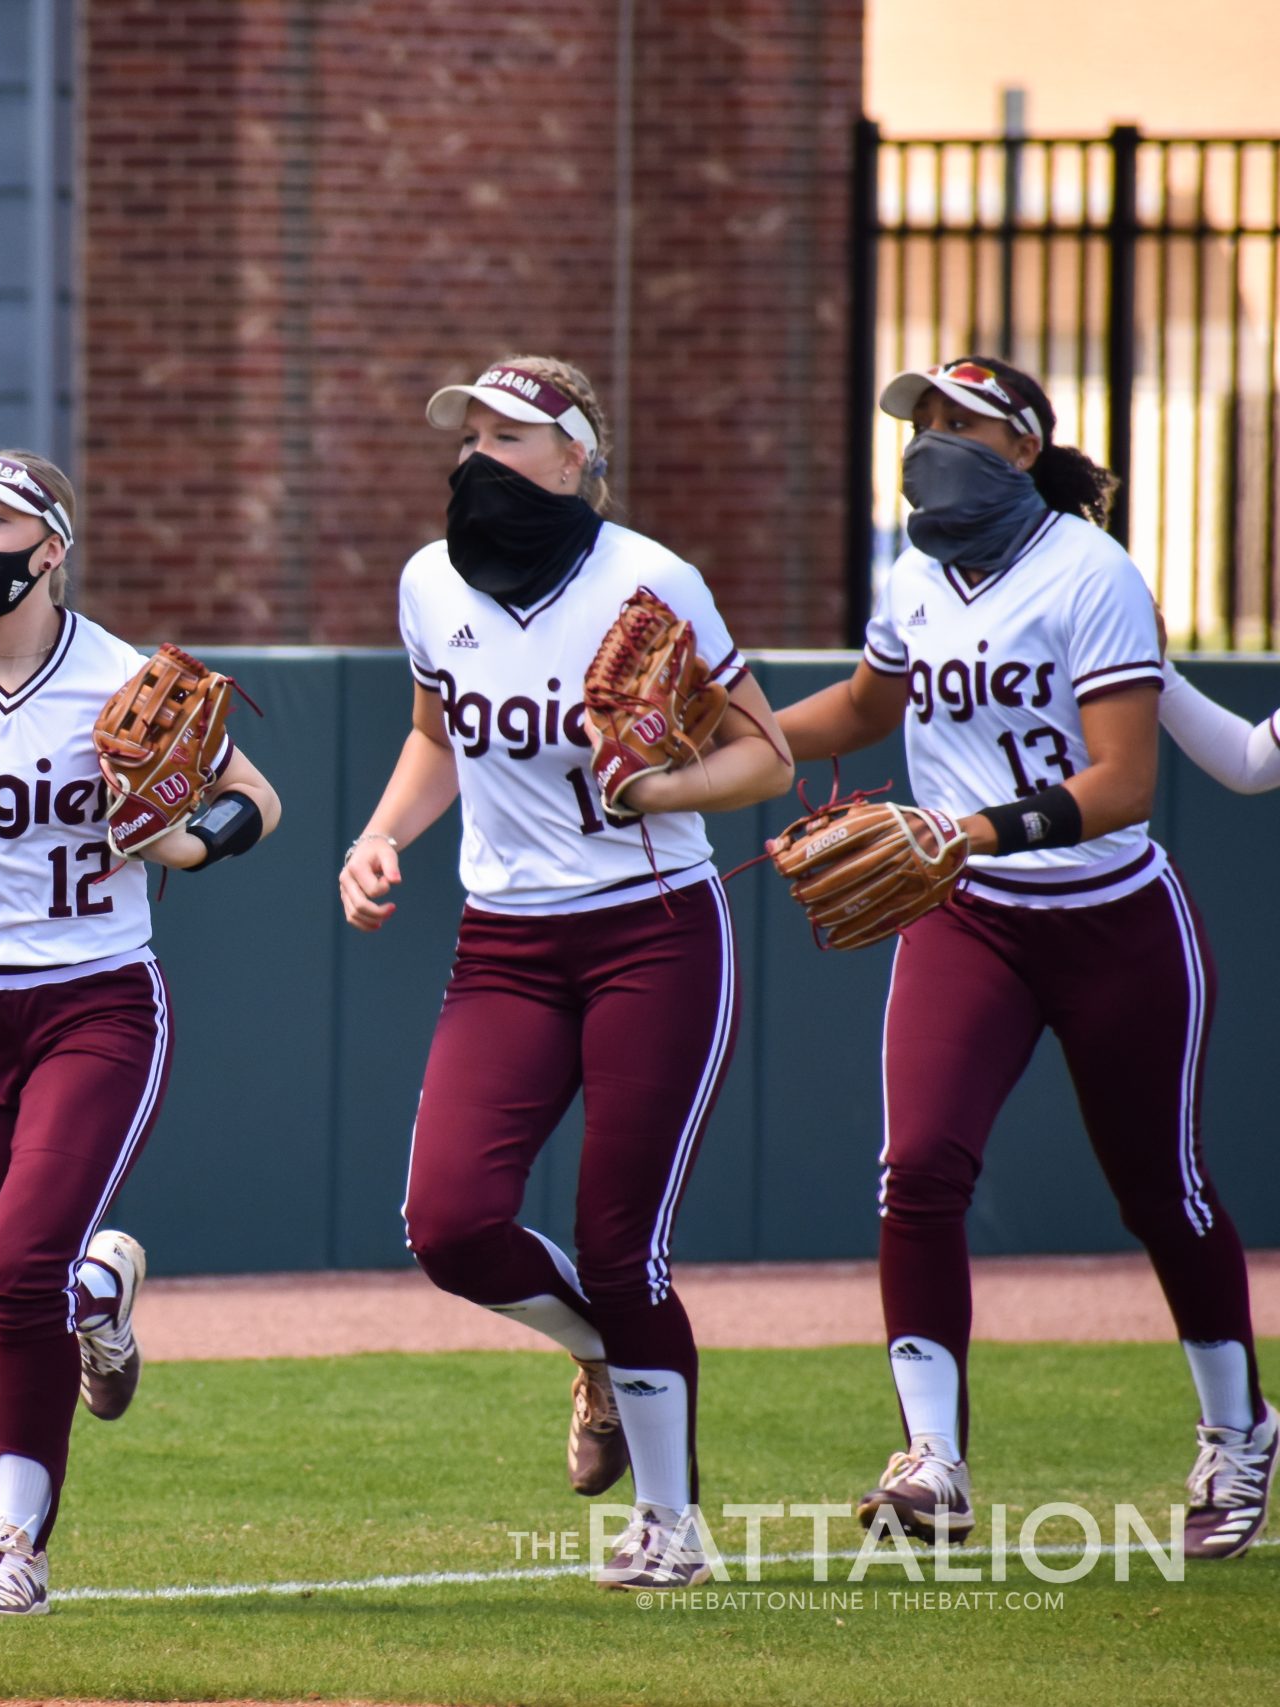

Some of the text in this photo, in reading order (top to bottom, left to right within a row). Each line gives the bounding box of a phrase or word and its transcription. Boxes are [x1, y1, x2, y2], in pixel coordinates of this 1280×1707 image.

[498, 371, 541, 400] A&M
[903, 639, 1055, 725] ggies
[997, 726, 1075, 798] 13
[48, 842, 114, 919] 12
